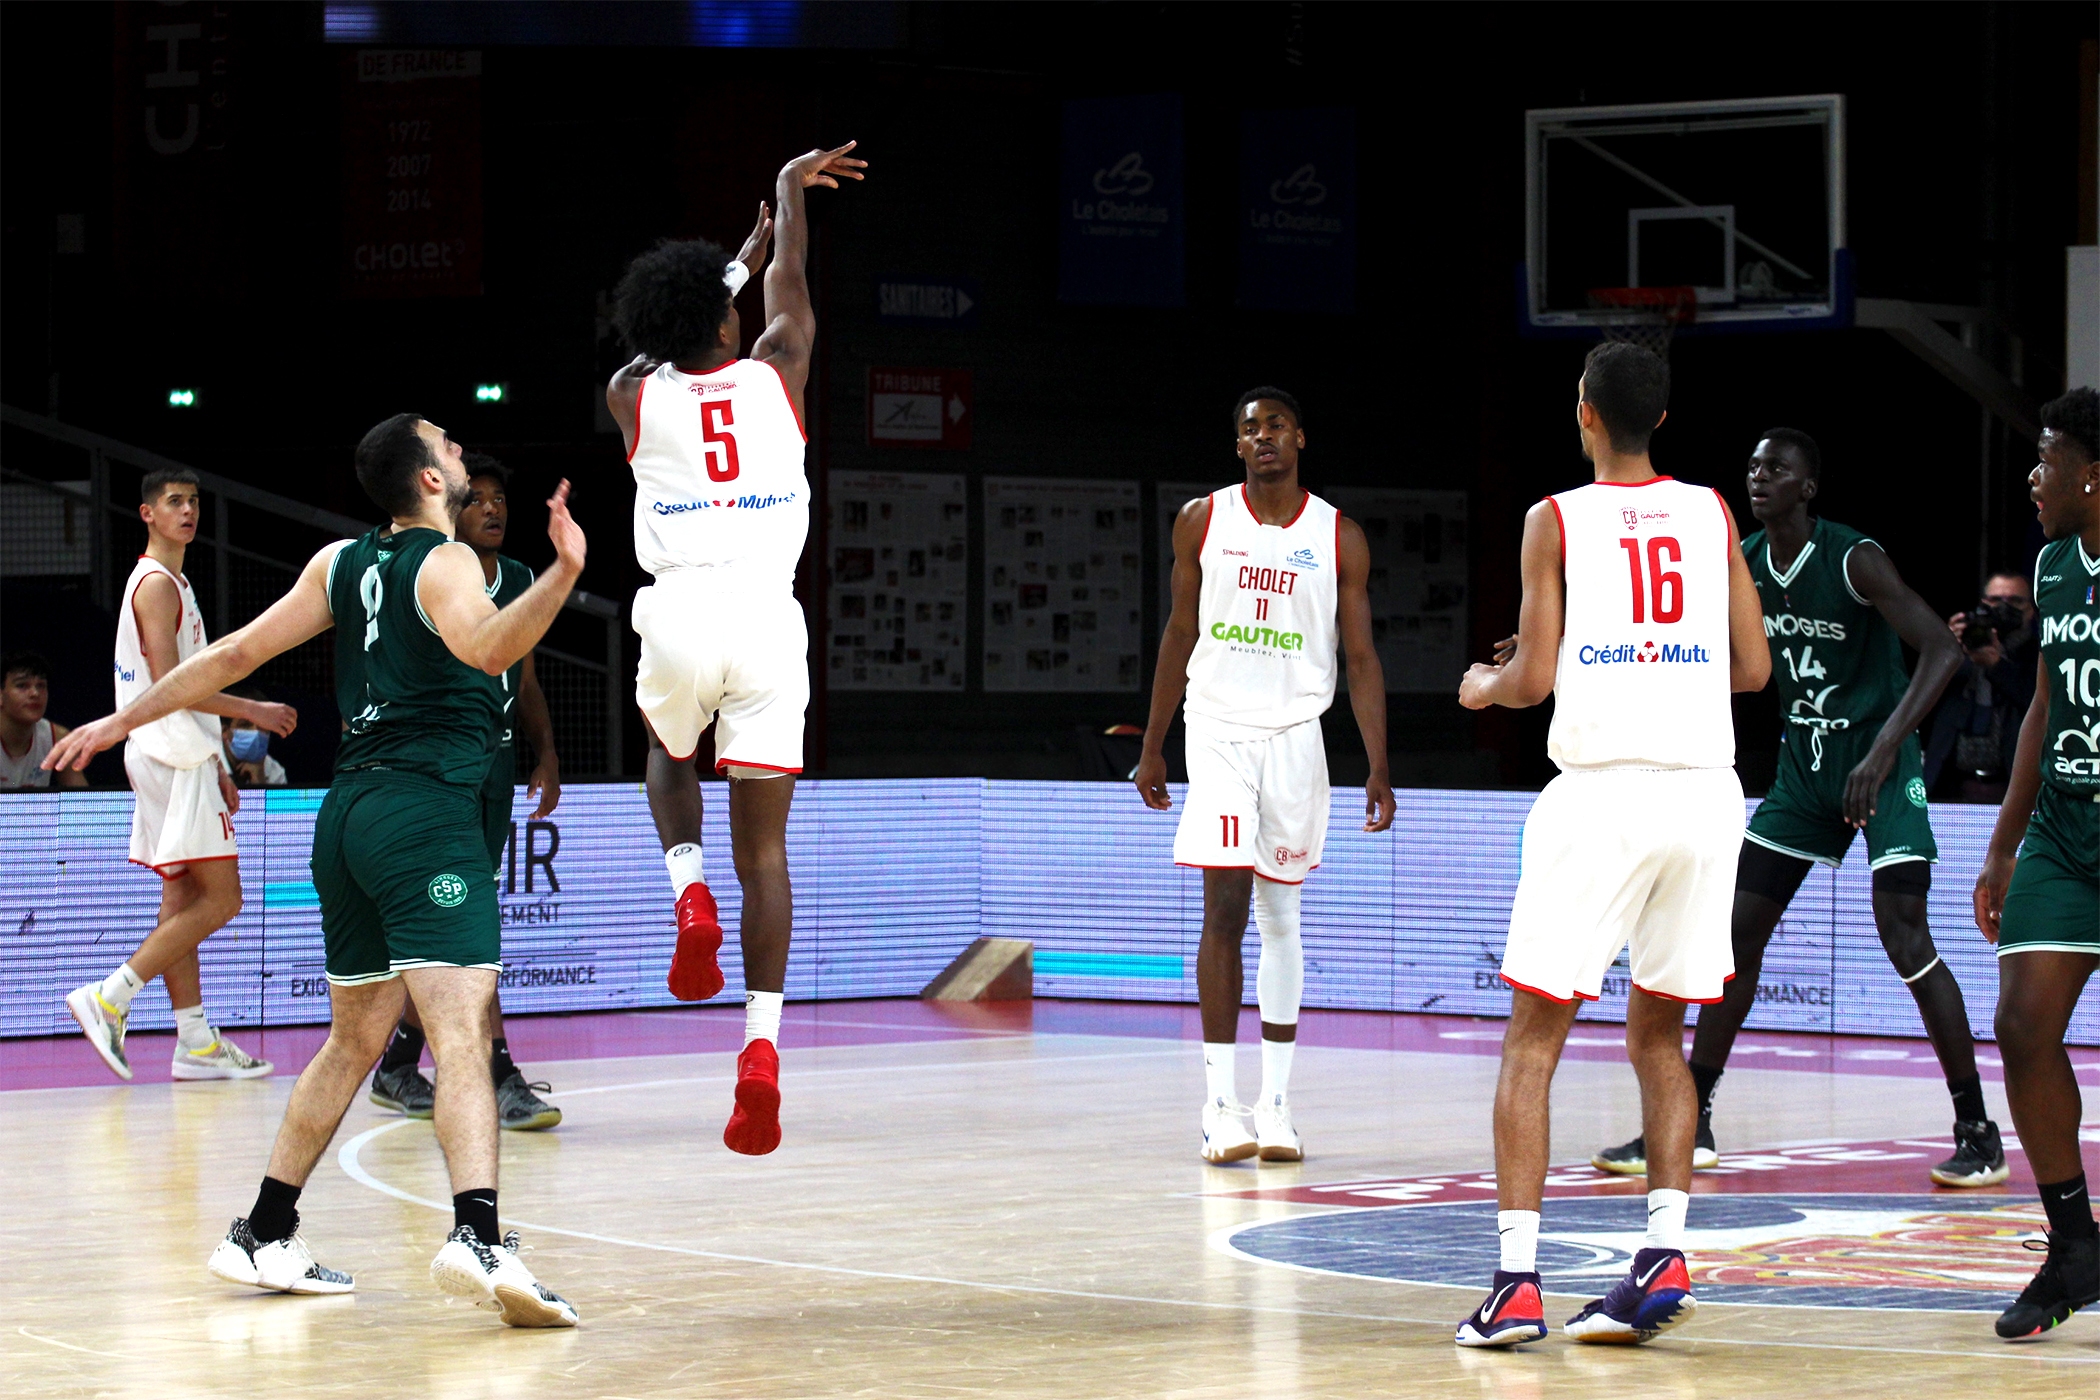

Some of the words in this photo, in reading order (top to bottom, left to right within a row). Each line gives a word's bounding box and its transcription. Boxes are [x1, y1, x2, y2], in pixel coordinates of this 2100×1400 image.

[363, 55, 386, 76] DE
[391, 51, 467, 74] FRANCE
[144, 0, 201, 155] CH
[387, 119, 433, 143] 1972
[385, 153, 433, 178] 2007
[386, 187, 433, 213] 2014
[1071, 198, 1095, 220] Le
[874, 373, 942, 392] TRIBUNE
[700, 399, 740, 483] 5
[1622, 510, 1638, 524] CB
[1238, 565, 1298, 596] CHOLET
[1619, 536, 1683, 624] 16
[1255, 598, 1269, 621] 11
[1210, 622, 1304, 651] GAUTIER
[2041, 612, 2100, 648] IMO
[1579, 644, 1636, 665] Crédit
[1781, 645, 1827, 683] 14
[2058, 658, 2100, 707] 10
[1220, 815, 1239, 847] 11
[1276, 850, 1288, 861] CB
[433, 880, 462, 897] CSP
